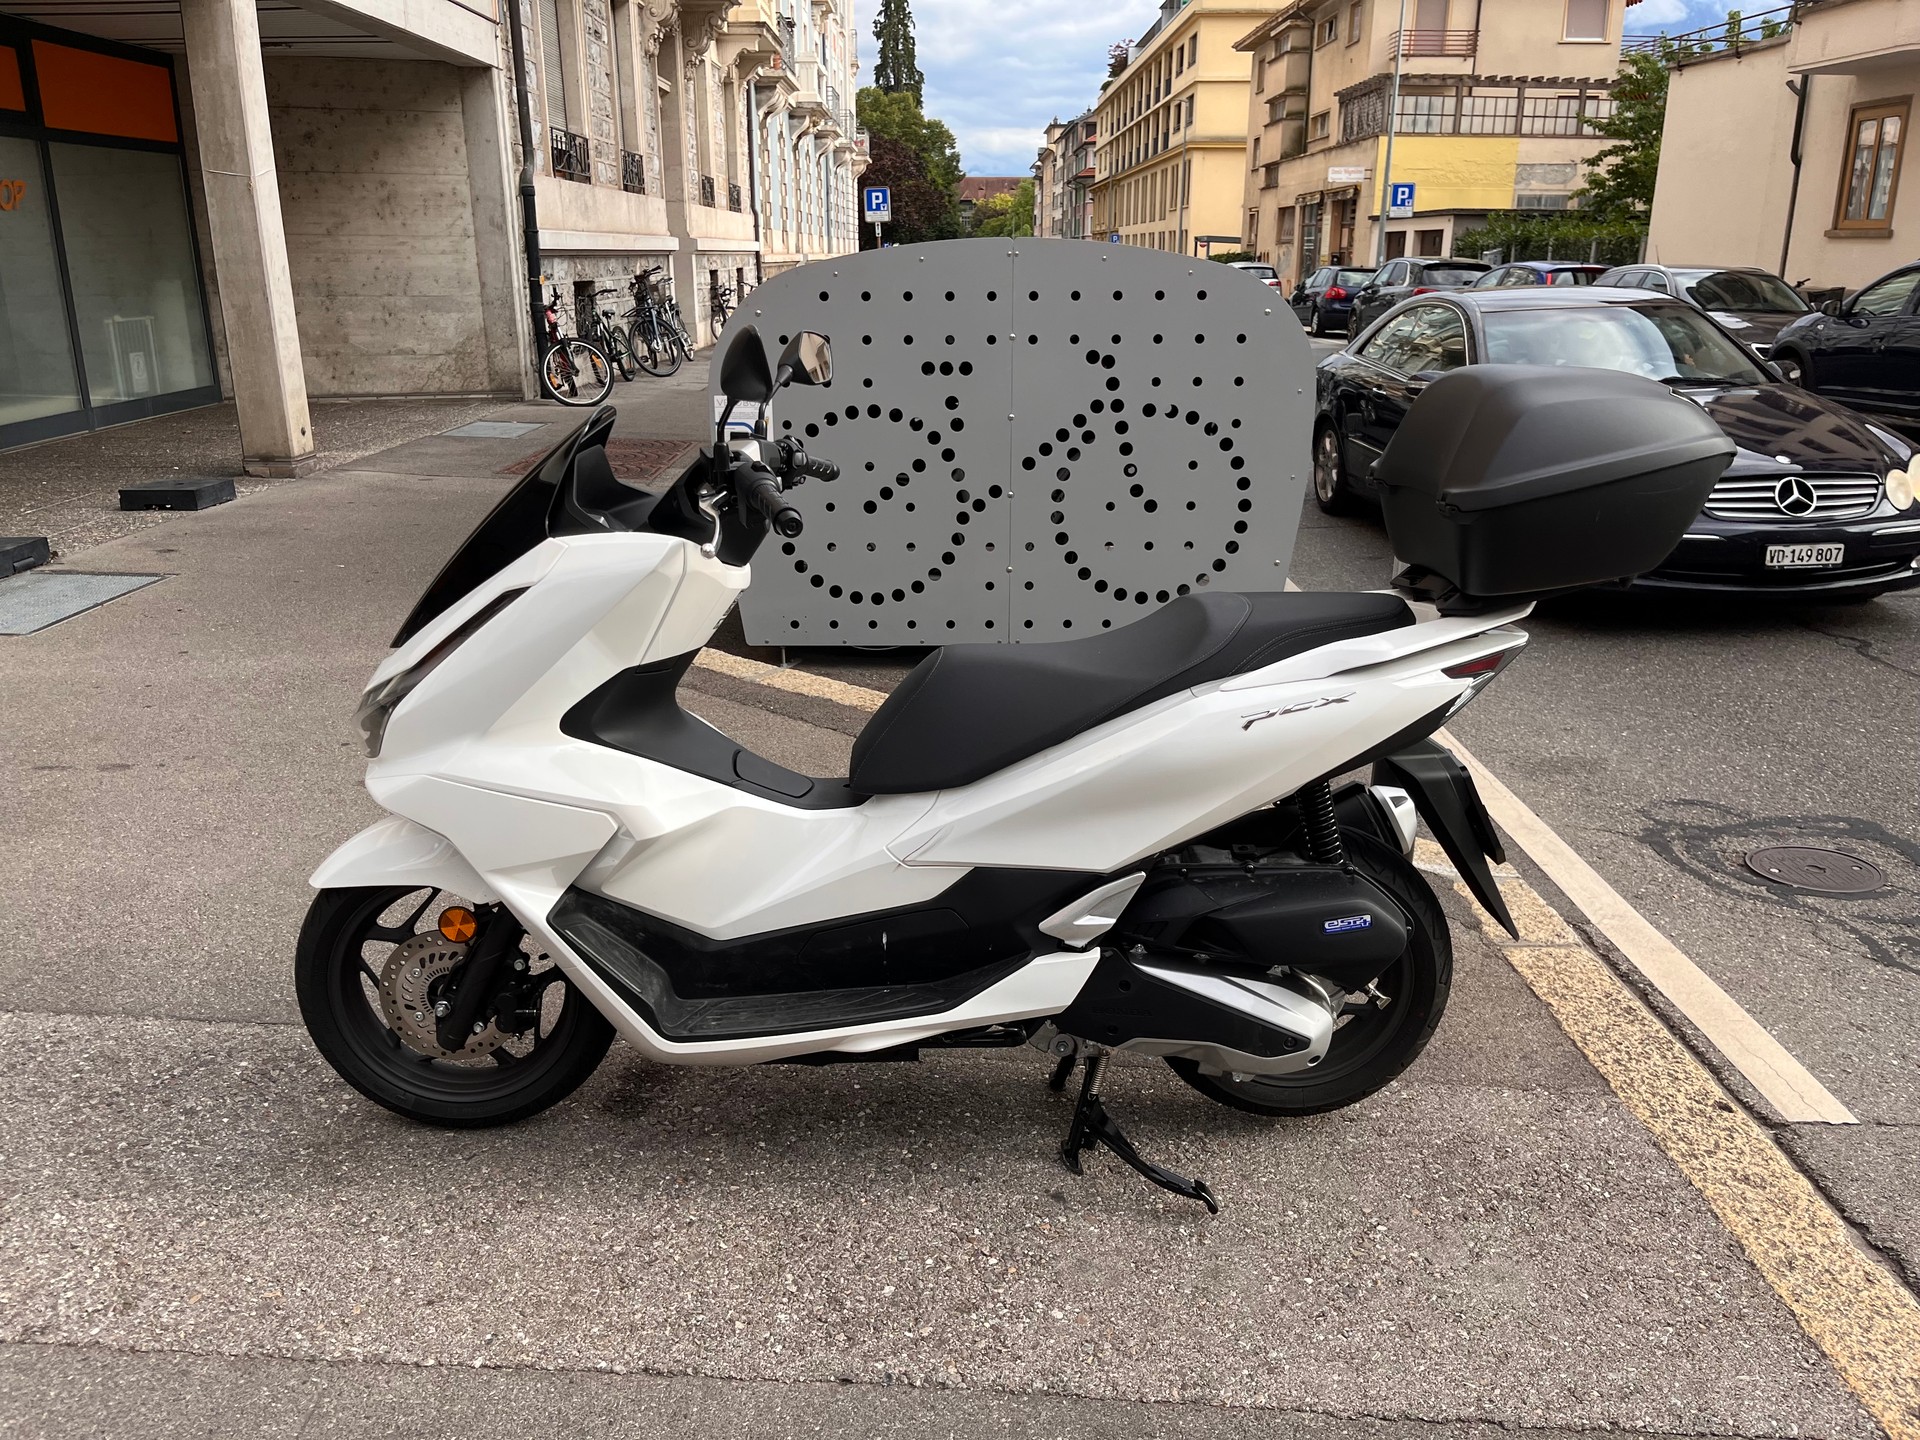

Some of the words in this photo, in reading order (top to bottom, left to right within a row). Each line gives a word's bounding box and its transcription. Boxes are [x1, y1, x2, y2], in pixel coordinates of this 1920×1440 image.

[871, 192, 883, 210] P
[1396, 187, 1410, 205] P
[1815, 547, 1842, 562] 807
[1241, 692, 1357, 731] PCX
